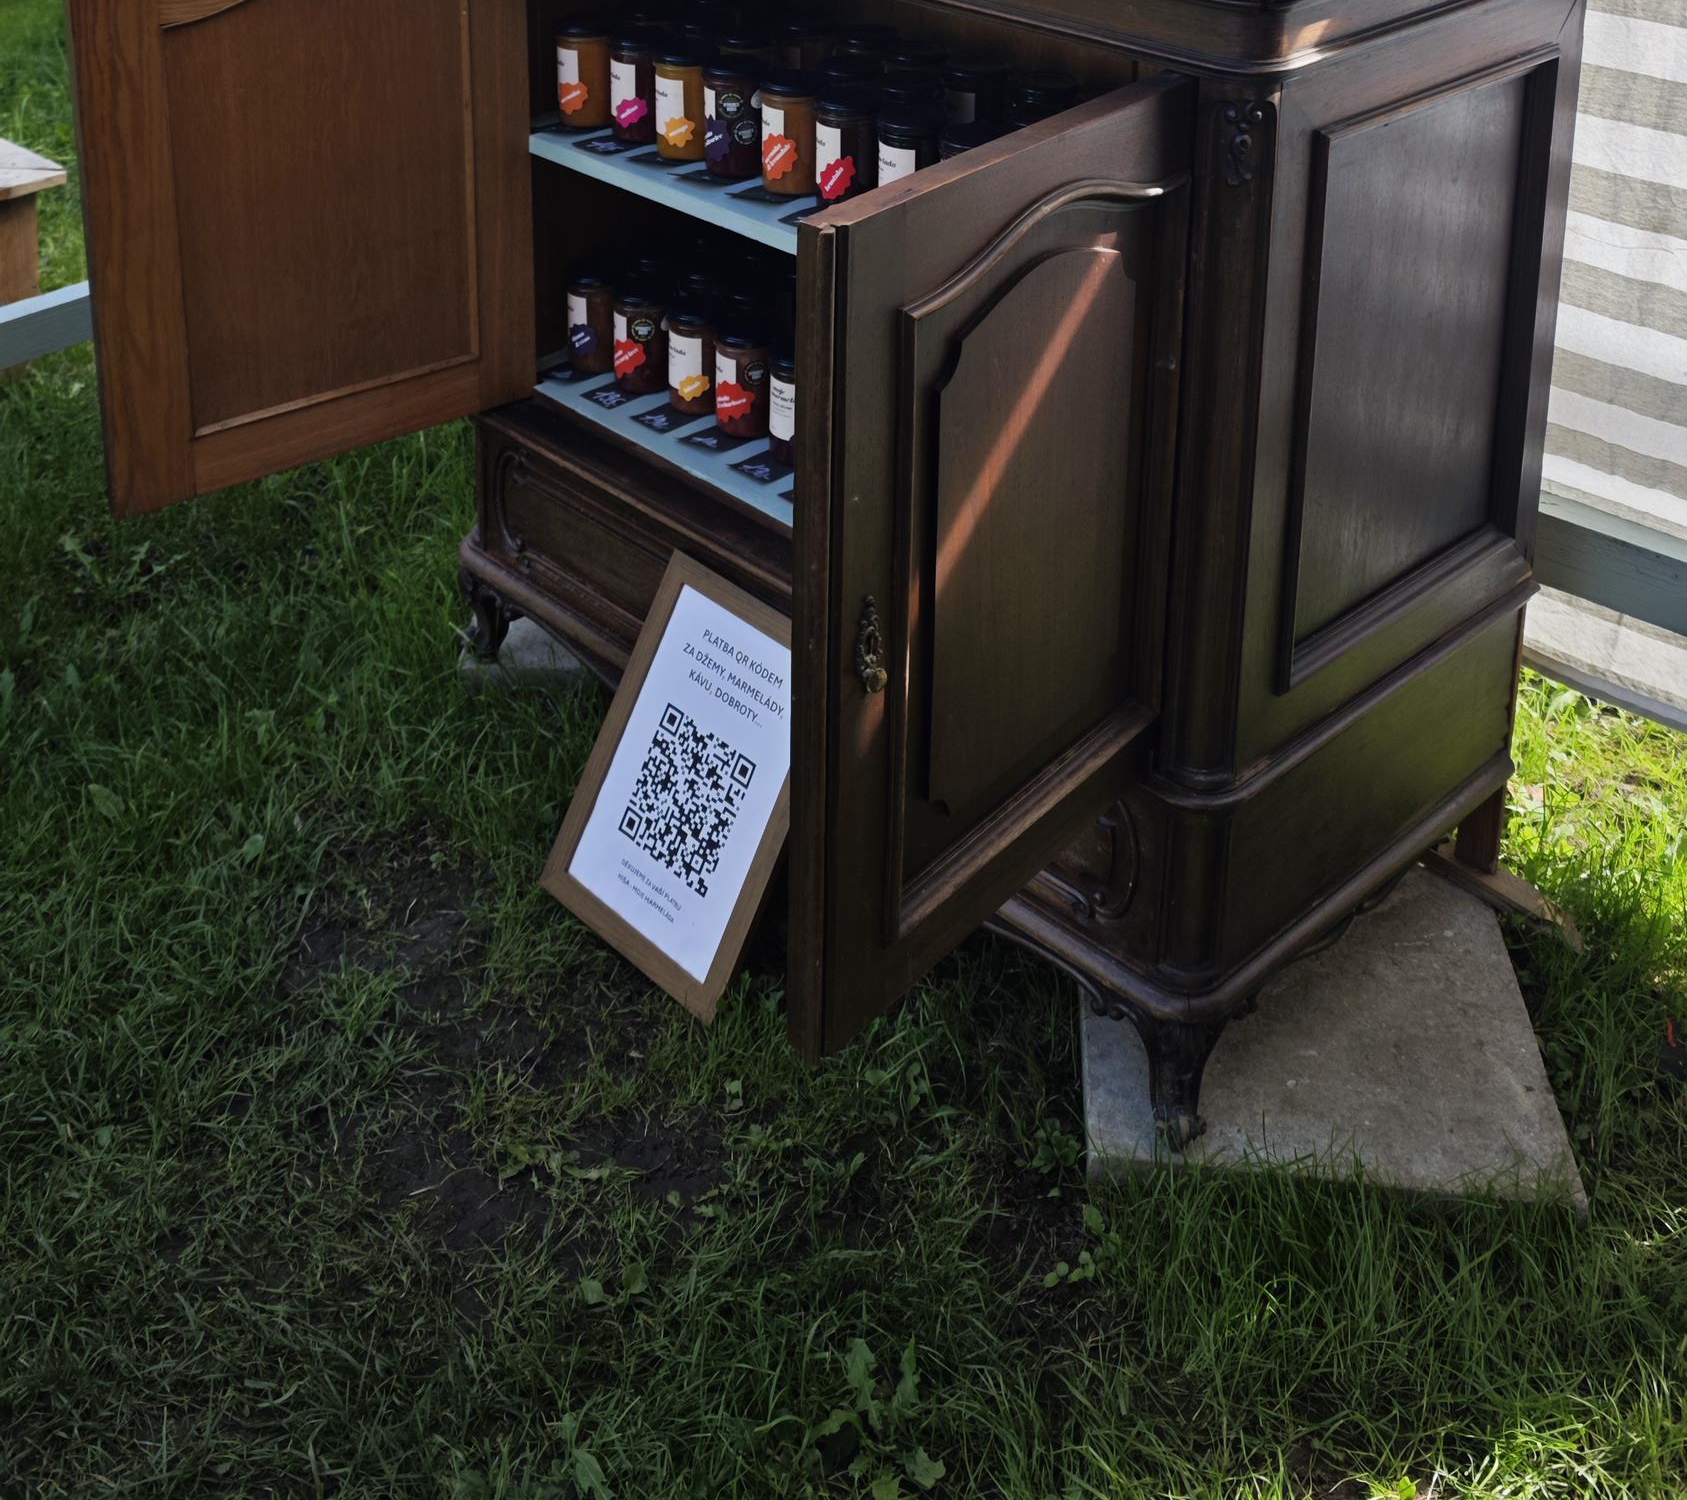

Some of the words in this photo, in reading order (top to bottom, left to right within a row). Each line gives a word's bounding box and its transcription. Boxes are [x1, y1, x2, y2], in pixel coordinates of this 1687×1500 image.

[683, 642, 695, 658] ZA
[695, 650, 726, 680] DŽEMY,
[727, 672, 785, 720] MARMELÁDY,
[689, 668, 713, 695] KÁVU,
[702, 629, 735, 658] PLATBA
[735, 651, 750, 667] QR
[749, 659, 784, 689] KÓDEM
